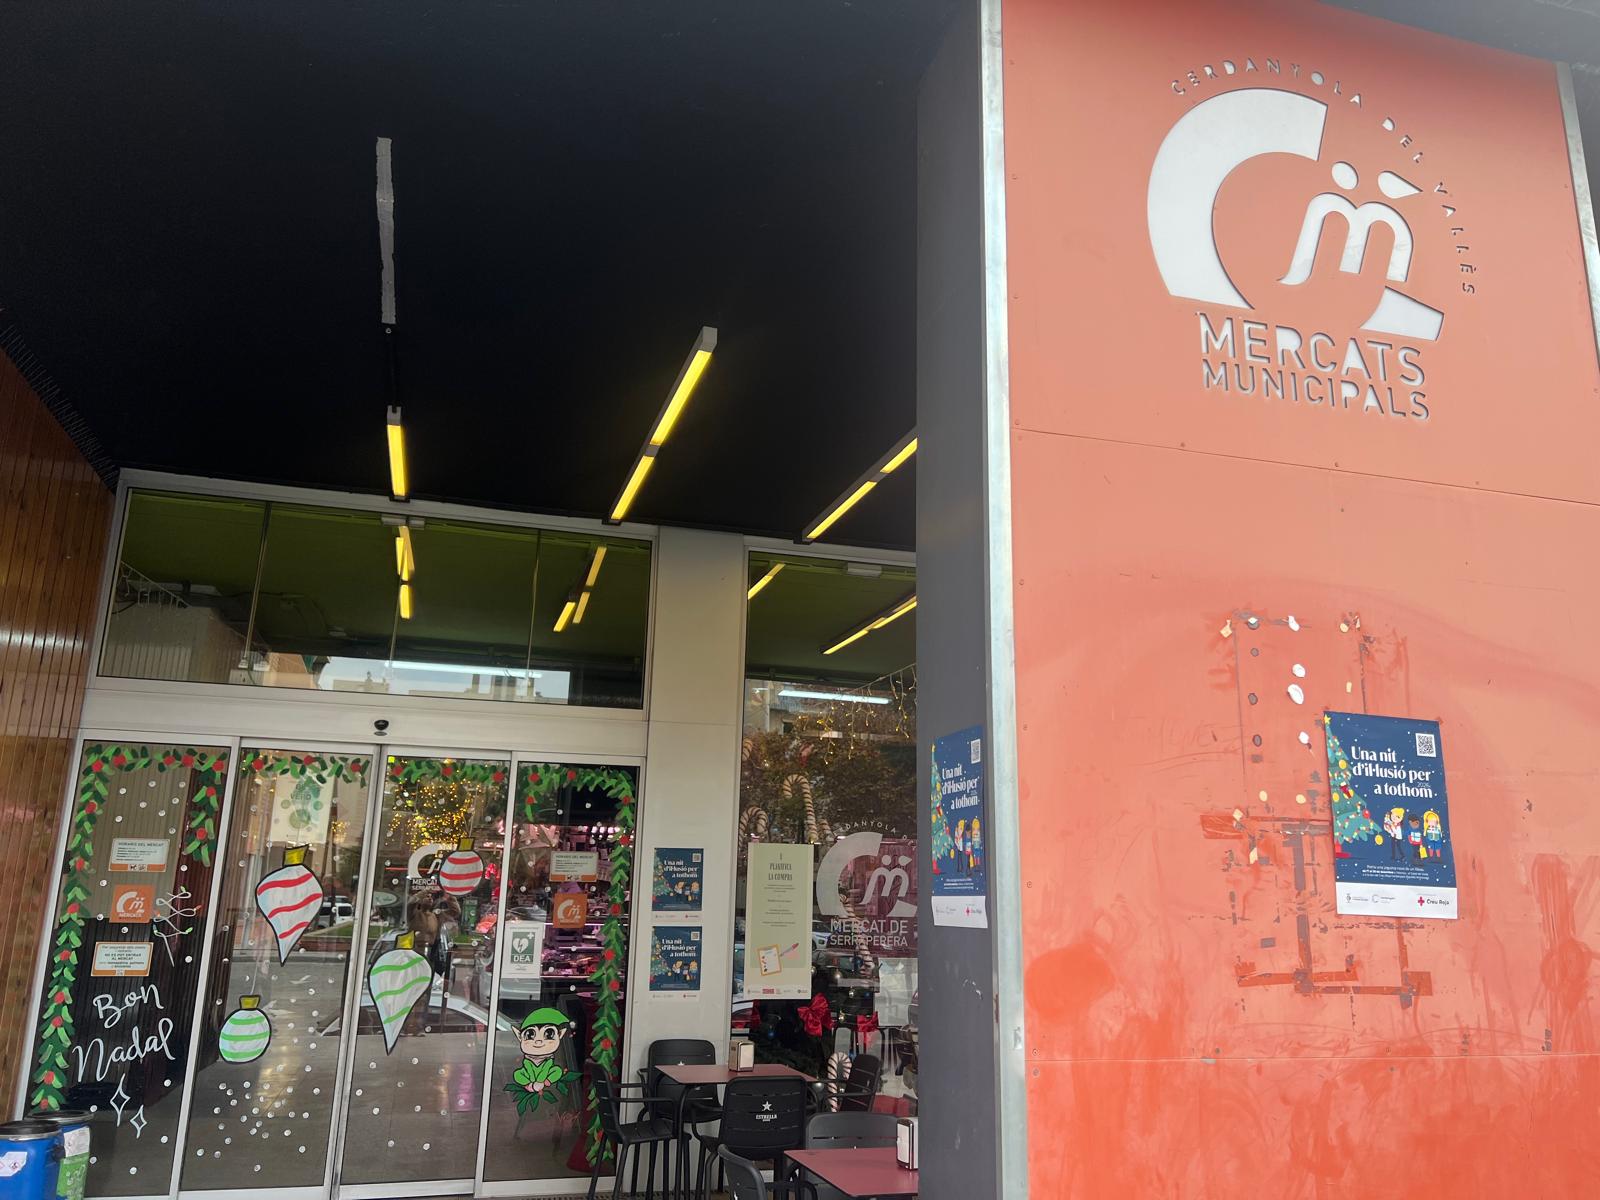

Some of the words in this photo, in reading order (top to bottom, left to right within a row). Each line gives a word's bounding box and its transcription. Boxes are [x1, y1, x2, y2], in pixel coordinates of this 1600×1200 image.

[1171, 57, 1362, 108] CERDANYOLA
[1381, 116, 1423, 163] DEL
[1196, 312, 1425, 386] MERCATS
[1202, 358, 1430, 420] MUNICIPALS
[1351, 745, 1378, 761] Una
[1379, 747, 1397, 763] nit
[942, 766, 954, 780] Una
[953, 763, 963, 777] nit
[1408, 769, 1431, 783] per
[966, 777, 978, 793] per
[1373, 783, 1382, 795] a
[1384, 782, 1433, 799] tothom
[955, 793, 978, 809] tothom
[830, 919, 887, 934] MERCAT
[890, 919, 909, 934] DE
[93, 984, 164, 1029] Bon
[72, 1018, 176, 1083] Nadal
